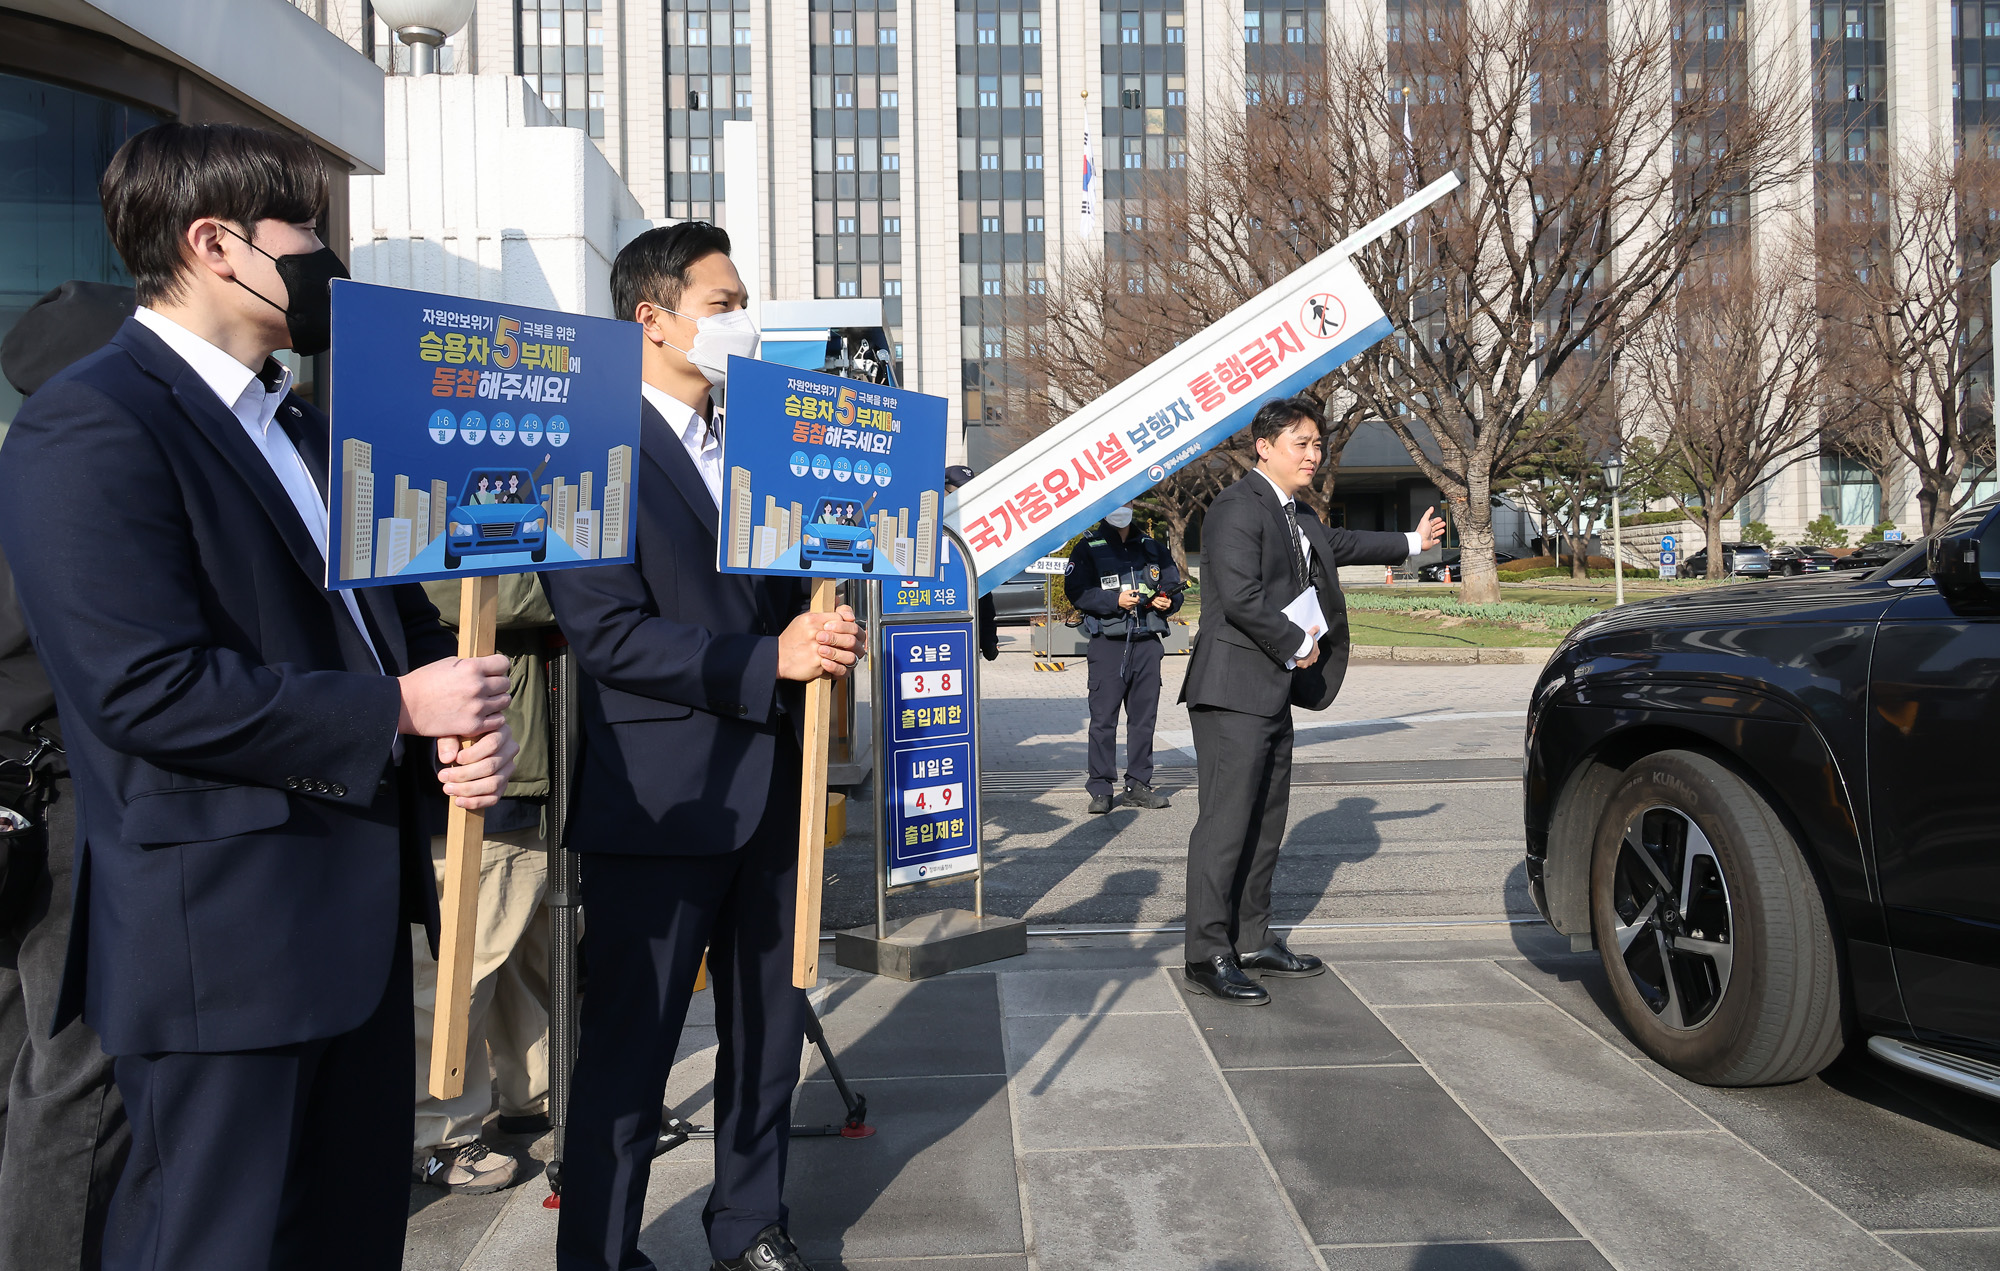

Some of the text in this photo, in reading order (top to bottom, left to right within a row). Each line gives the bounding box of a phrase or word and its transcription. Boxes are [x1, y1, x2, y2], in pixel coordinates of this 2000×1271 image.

[422, 308, 577, 342] 자원안보위기 극복을 위한
[419, 330, 490, 366] 승용차
[431, 366, 571, 404] 동참해주세요!
[787, 378, 898, 409] 자원안보위기 극복을 위한
[784, 394, 834, 422] 승용차
[438, 430, 562, 444] 월 화 수 목 금
[792, 420, 893, 455] 동참해주세요!
[962, 320, 1306, 553] 국가중요시설 보행자 통행금지
[839, 471, 846, 480] 수
[896, 588, 957, 606] 요일제 적용
[909, 643, 952, 663] 오늘은
[941, 673, 951, 691] 8
[901, 705, 962, 729] 출입제한
[912, 757, 954, 779] 내일은
[942, 788, 952, 806] 9
[1652, 771, 1699, 806] KUMHO
[905, 818, 964, 846] 출입제한
